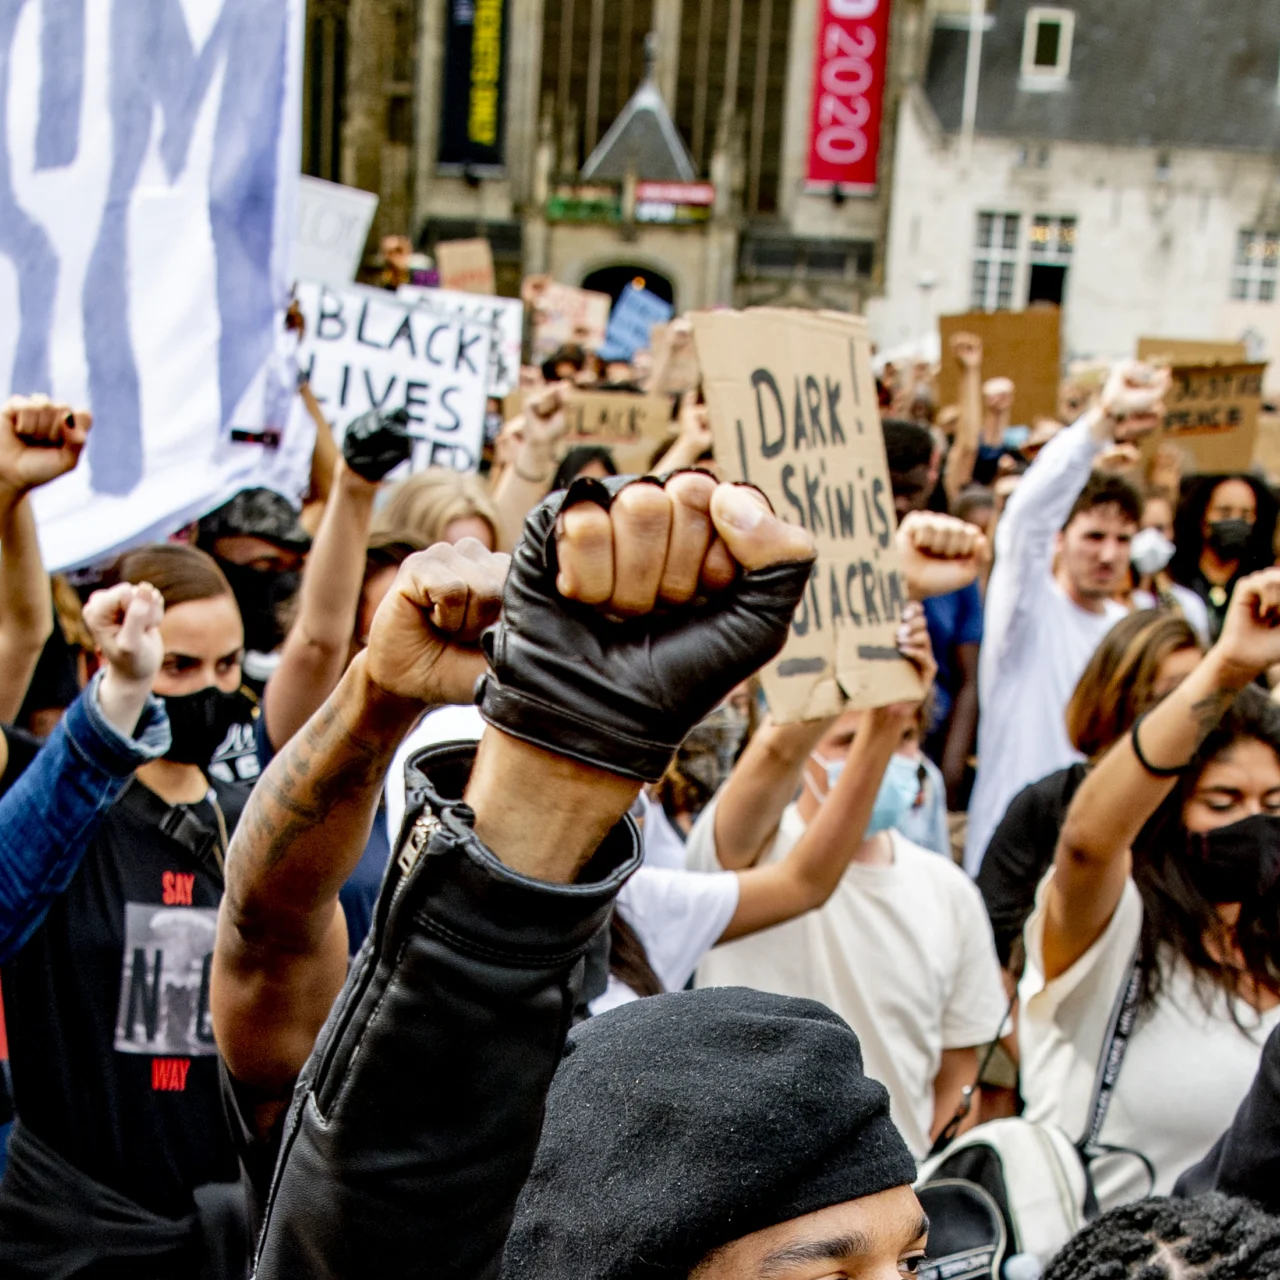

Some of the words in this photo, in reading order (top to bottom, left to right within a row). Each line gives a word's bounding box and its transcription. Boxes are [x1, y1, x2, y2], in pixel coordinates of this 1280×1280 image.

[815, 24, 877, 164] 2020
[316, 290, 481, 375] BLACK
[750, 367, 847, 460] DARK
[161, 869, 195, 906] SAY
[151, 1058, 191, 1092] WAY
